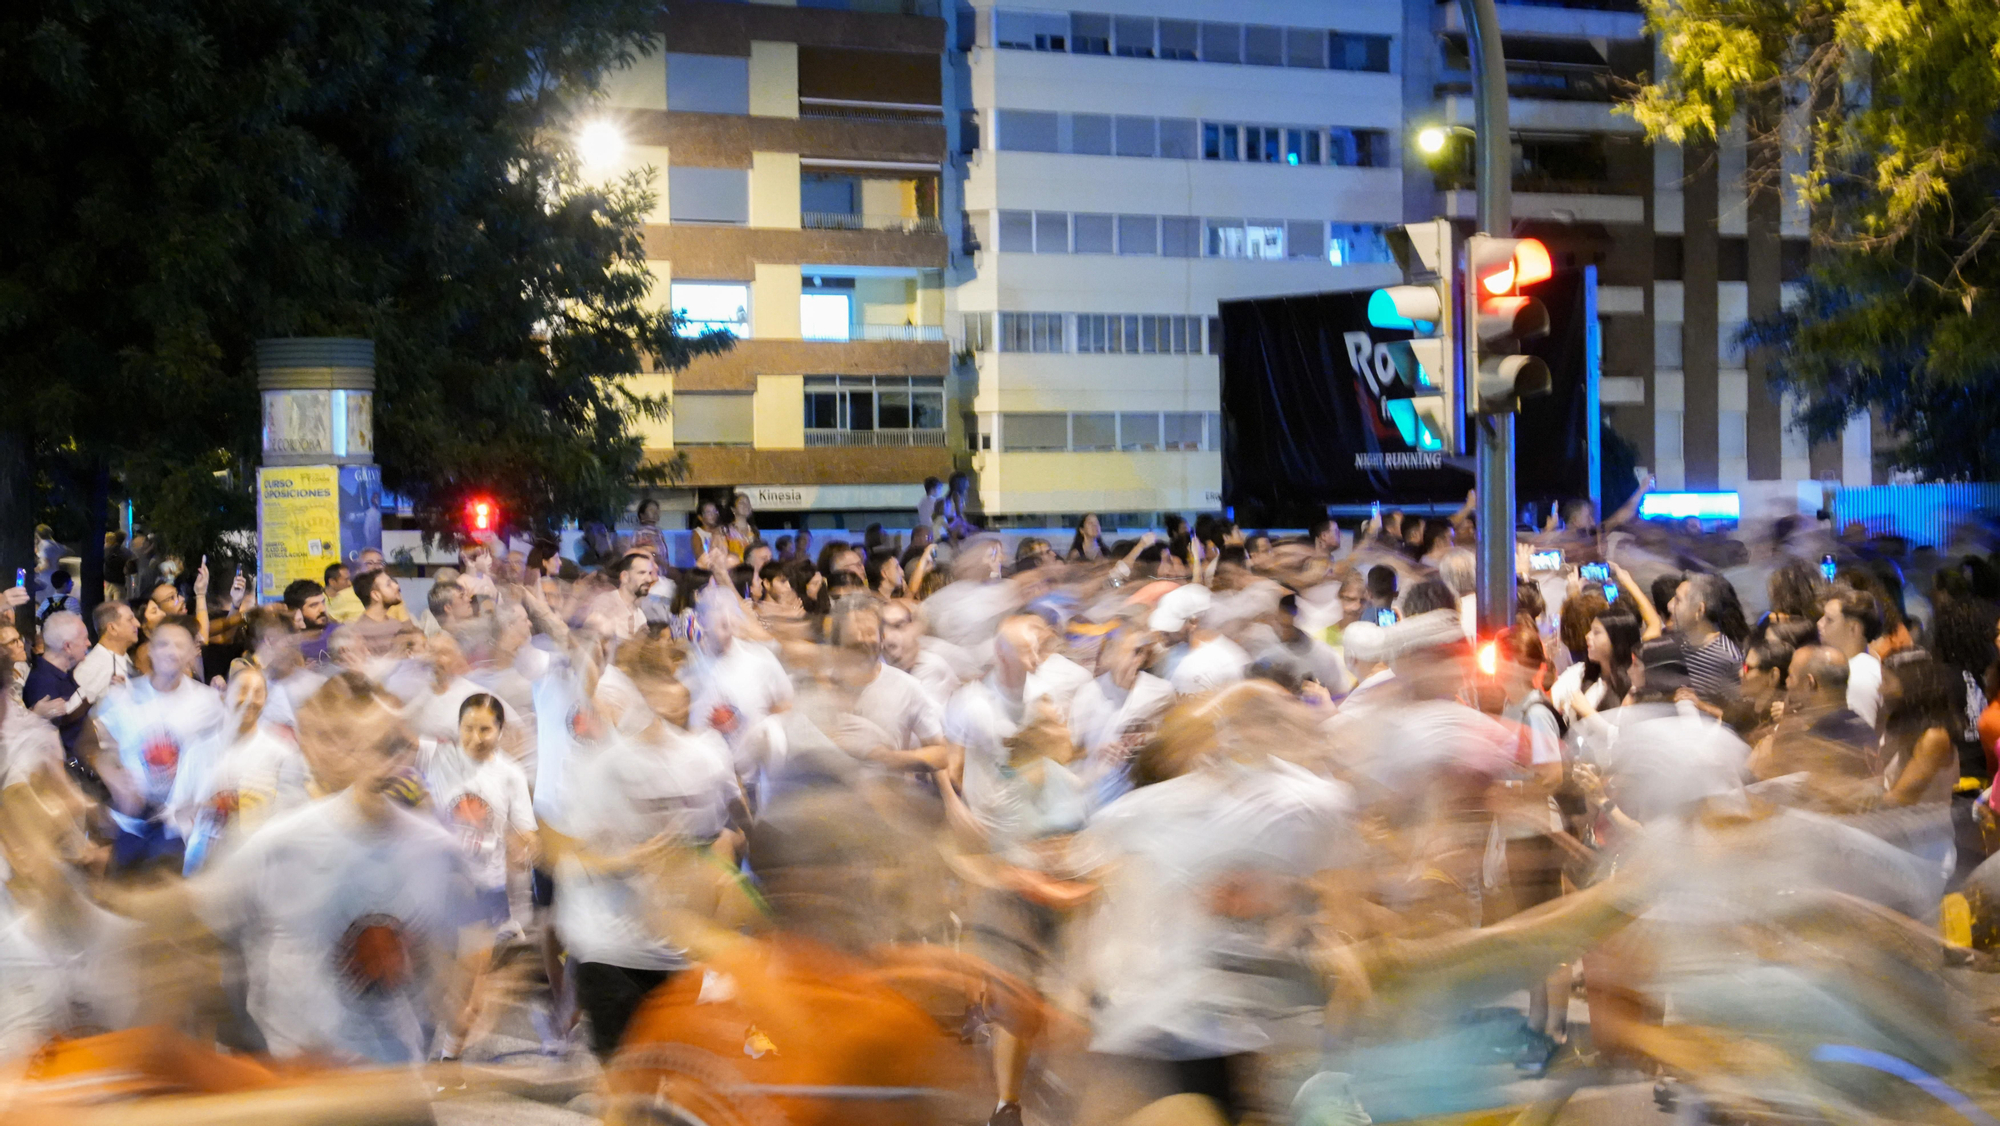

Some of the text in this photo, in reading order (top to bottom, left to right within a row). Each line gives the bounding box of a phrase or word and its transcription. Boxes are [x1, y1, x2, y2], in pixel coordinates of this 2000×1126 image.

[1355, 452, 1442, 470] NIGHT RUNNING
[264, 479, 294, 489] CURSO
[264, 488, 331, 499] OPOSICIONES
[759, 488, 802, 501] Kinesia
